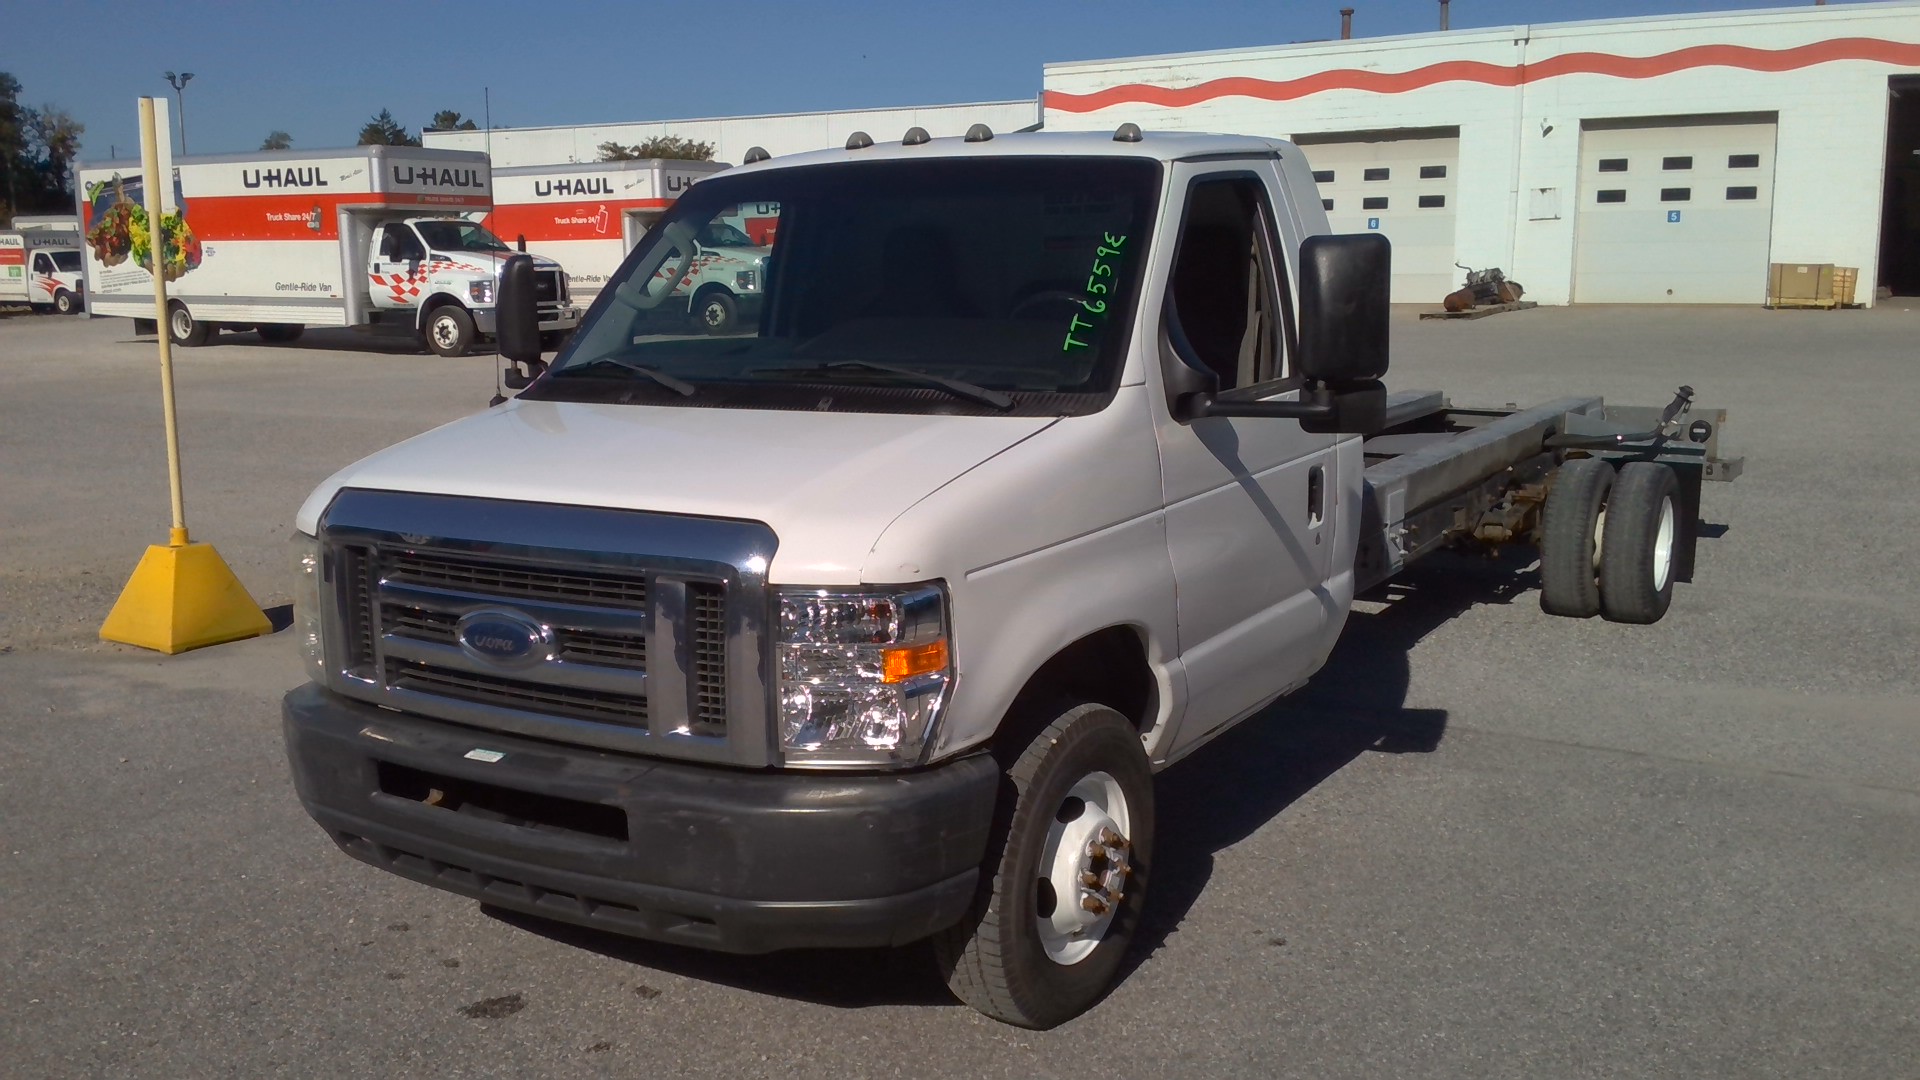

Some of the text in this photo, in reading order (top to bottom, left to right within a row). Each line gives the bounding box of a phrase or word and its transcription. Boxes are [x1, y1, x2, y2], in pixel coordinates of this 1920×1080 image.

[243, 167, 328, 188] U-HAUL
[393, 166, 484, 188] U-HAUL
[535, 177, 614, 197] U-HAUL
[266, 211, 316, 222] Truck Share 24/7
[571, 216, 588, 224] Share
[1670, 212, 1677, 221] 5
[1370, 219, 1376, 228] 6
[567, 275, 601, 283] entle-Ride
[275, 281, 332, 292] Gentle-Ride Van
